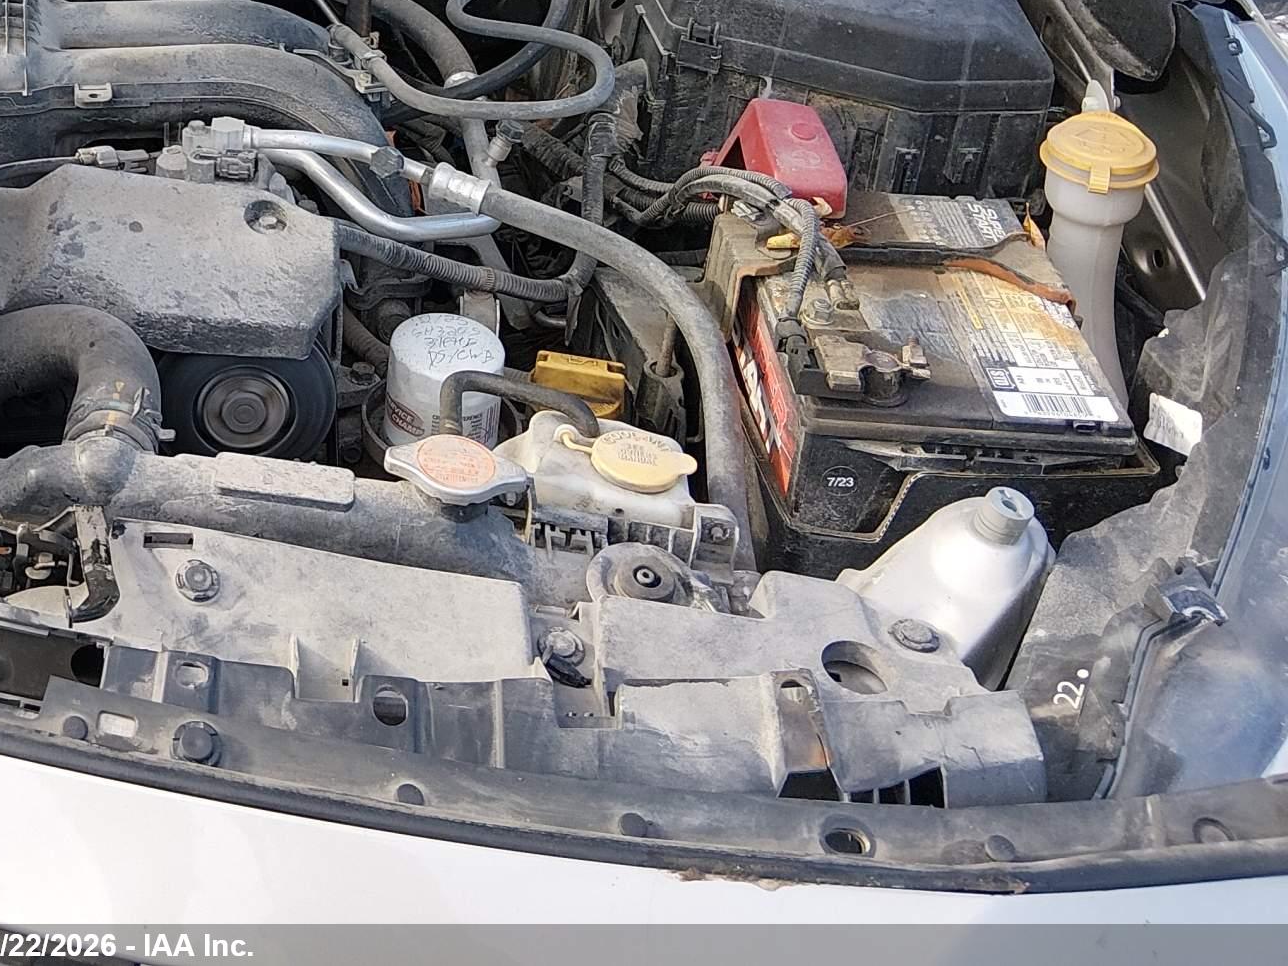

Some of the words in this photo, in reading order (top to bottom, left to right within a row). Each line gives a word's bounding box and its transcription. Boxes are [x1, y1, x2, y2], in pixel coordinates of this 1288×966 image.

[967, 202, 999, 243] START
[986, 209, 1007, 241] SUPE
[392, 413, 425, 436] CHAMP
[826, 476, 855, 488] 7/23
